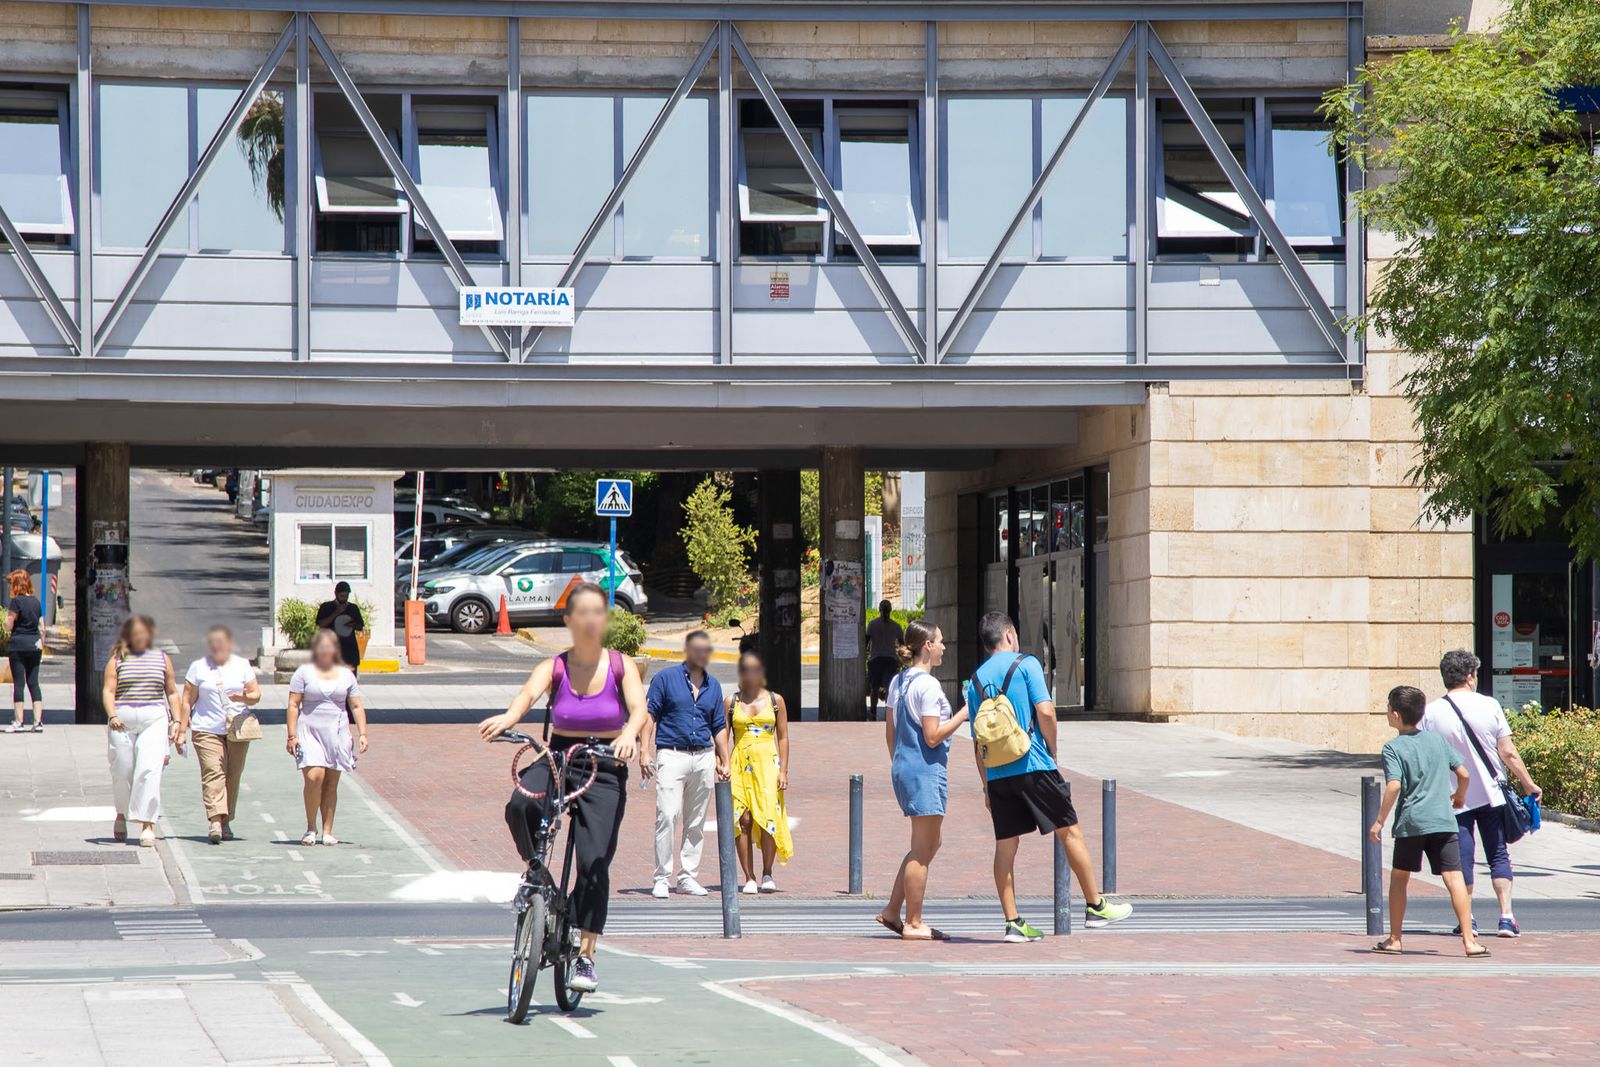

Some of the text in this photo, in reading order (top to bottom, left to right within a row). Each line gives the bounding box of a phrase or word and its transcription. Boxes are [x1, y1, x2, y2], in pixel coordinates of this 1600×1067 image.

[485, 290, 570, 306] NOTARÍA
[296, 495, 374, 508] CIUDADEXPO
[202, 884, 323, 895] STOP
